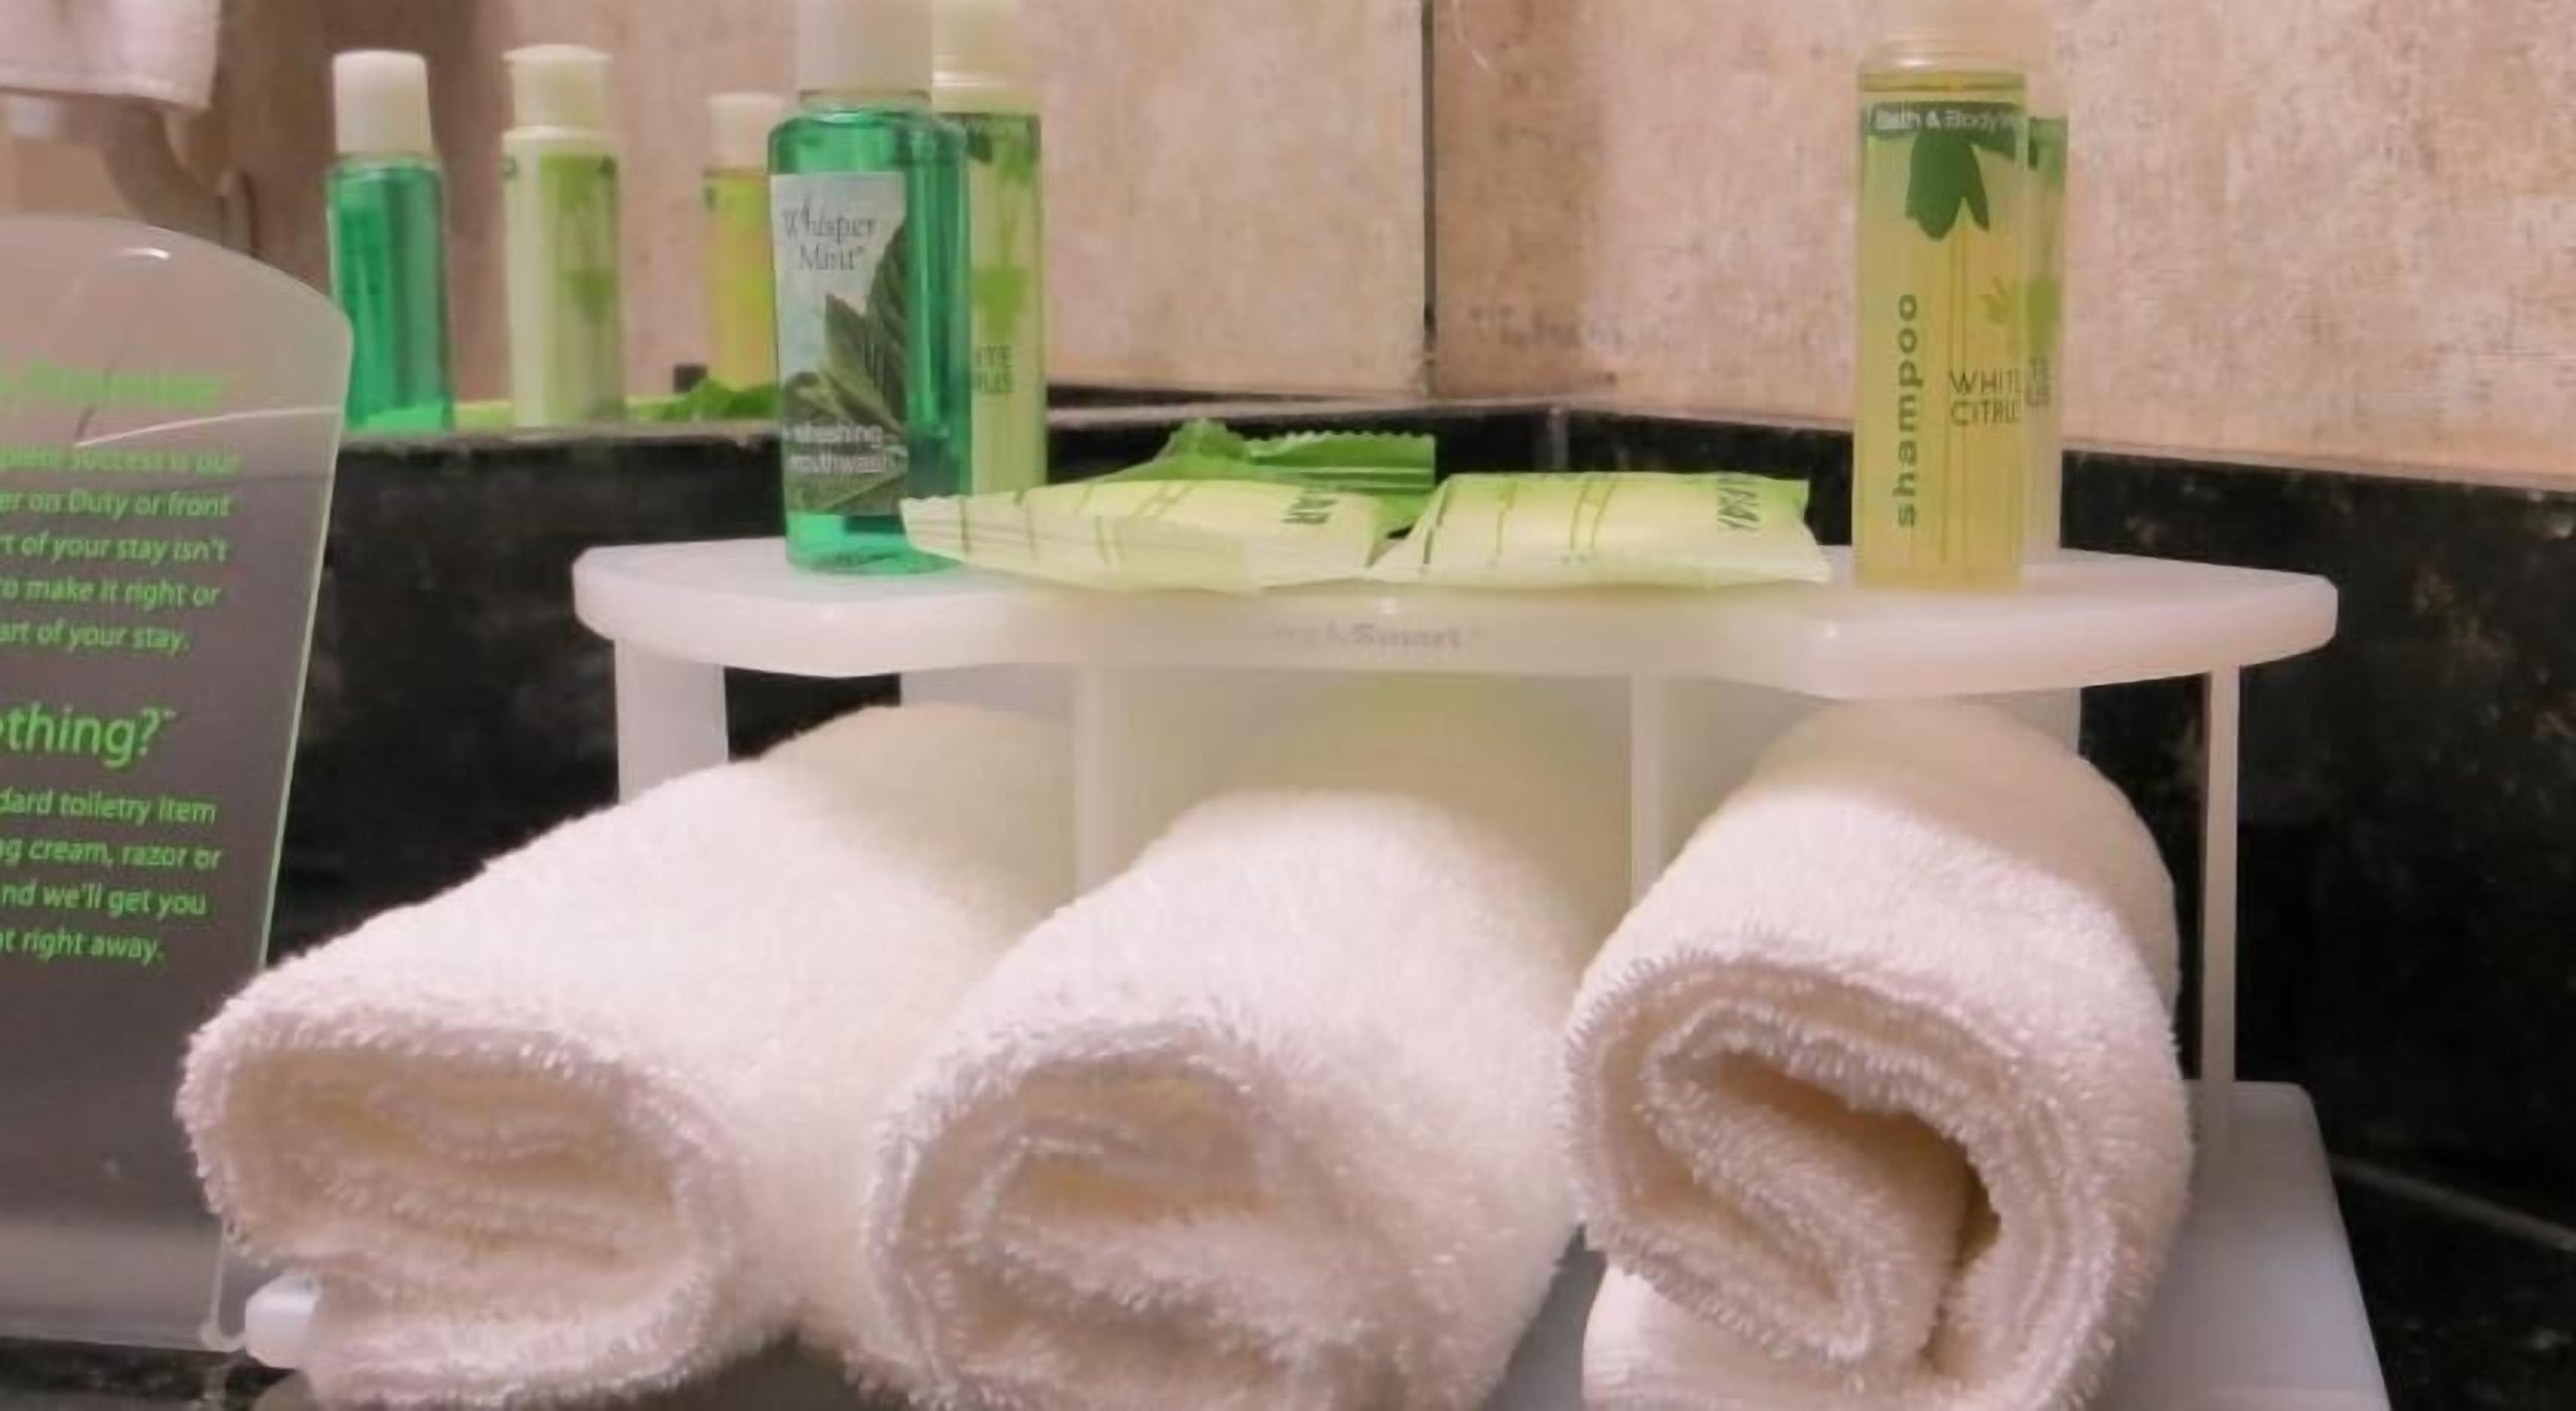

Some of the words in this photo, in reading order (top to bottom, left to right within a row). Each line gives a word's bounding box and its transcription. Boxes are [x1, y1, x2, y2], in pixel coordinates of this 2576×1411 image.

[781, 196, 879, 245] Whisper
[1891, 293, 1924, 528] shampoo
[29, 495, 62, 513] on
[69, 488, 130, 522] Duty
[134, 496, 161, 516] or
[167, 492, 230, 516] front
[21, 529, 50, 555] of
[52, 539, 112, 564] your
[117, 538, 169, 565] stay
[172, 538, 228, 562] isn't
[25, 577, 95, 602] make
[100, 577, 118, 603] it
[124, 577, 187, 613] right
[192, 587, 222, 607] or
[37, 617, 65, 645] of
[68, 623, 128, 653] your
[133, 626, 192, 657] stay.
[0, 702, 161, 768] thing?
[59, 789, 151, 827] toiletry
[158, 794, 218, 825] item
[28, 840, 114, 868] cream,
[121, 844, 188, 868] razor
[192, 848, 222, 870] or
[42, 882, 103, 909] we'll
[107, 888, 151, 919] get
[156, 893, 207, 921] you
[22, 925, 84, 962] right
[90, 934, 166, 967] away.
